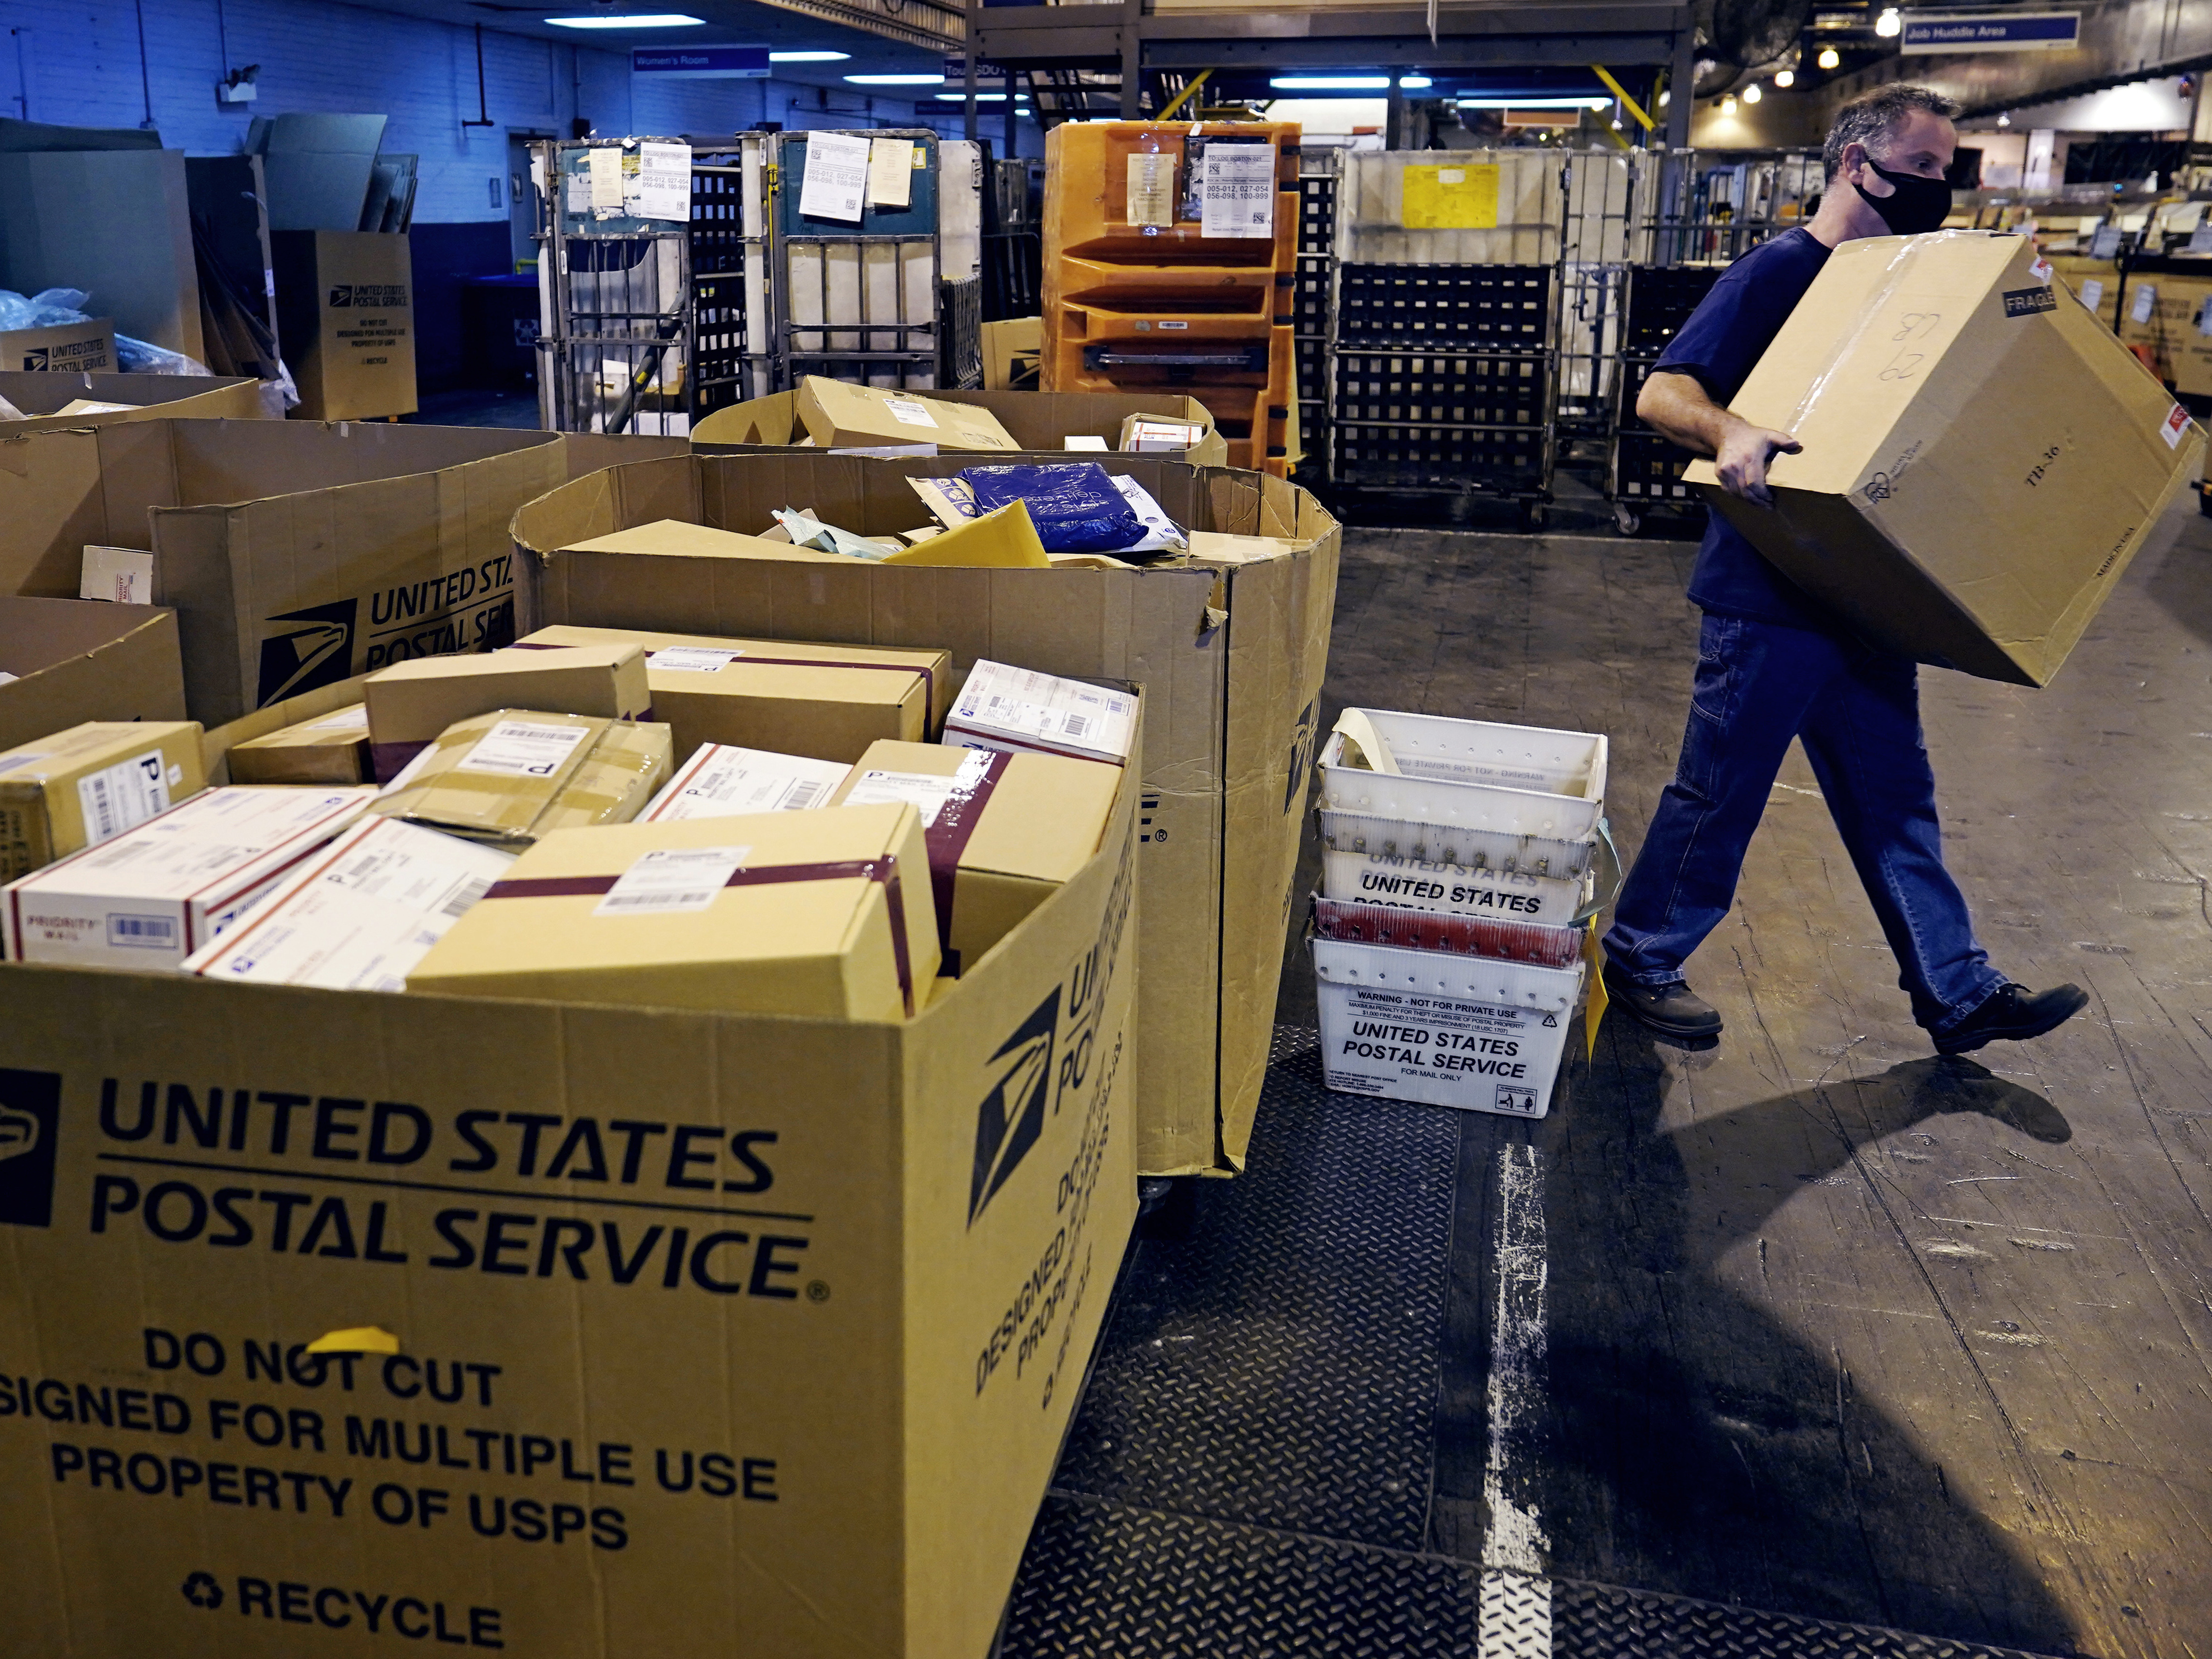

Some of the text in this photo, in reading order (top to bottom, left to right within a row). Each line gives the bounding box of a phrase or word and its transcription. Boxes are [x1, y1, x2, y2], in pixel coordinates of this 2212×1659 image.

[1907, 25, 2007, 40] Job Huddle Area
[636, 55, 709, 66] Women's Room
[945, 65, 966, 76] Tou
[836, 179, 862, 188] 100-999
[837, 173, 862, 181] 027-054
[353, 297, 407, 307] POSTAL SERVICE
[354, 285, 405, 296] UNITED STATES
[52, 338, 104, 358] UNITED STATES
[51, 354, 107, 372] POSTAL SERVICE
[2025, 446, 2061, 487] TB-36
[1003, 491, 1102, 502] delivered
[372, 553, 513, 625] UNITED STA
[366, 600, 514, 673] POSTAL SER
[141, 757, 160, 781] P
[528, 763, 556, 774] P
[686, 788, 703, 796] P
[1362, 874, 1445, 900] UNITED
[1450, 886, 1542, 914] STATES
[27, 915, 96, 930] PRIORITY
[44, 929, 78, 941] MAIL
[1349, 1001, 1376, 1010] MAXIMUM
[1412, 1008, 1430, 1016] THEFT
[1441, 1012, 1462, 1021] MISUSE
[1471, 1016, 1494, 1025] POSTAL
[1494, 1019, 1525, 1029] PROPERTY
[1357, 991, 1403, 1004] WARNING
[1410, 998, 1430, 1008] NOT
[1433, 1001, 1452, 1010] FOR
[1455, 1004, 1495, 1016] PRIVATE
[1497, 1009, 1517, 1018] USE
[1362, 1010, 1379, 1018] $1,000
[1429, 1017, 1471, 1029] IMPRISONMENT
[1481, 1024, 1493, 1032] USC
[1353, 1021, 1519, 1056] UNITED STATES
[1343, 1040, 1527, 1079] POSTAL SERVICE
[1401, 1067, 1462, 1082] FOR MAIL ONLY
[99, 1078, 780, 1194] UNITED STATES
[89, 1175, 410, 1264] POSTAL
[976, 1226, 1066, 1398] DESIGNED
[144, 1327, 503, 1407] DO NOT CUT
[0, 1373, 781, 1504] SIGNED FOR MULTIPLE USE
[51, 1441, 630, 1551] PROPERTY OF USPS
[236, 1575, 508, 1650] RECYCLE
